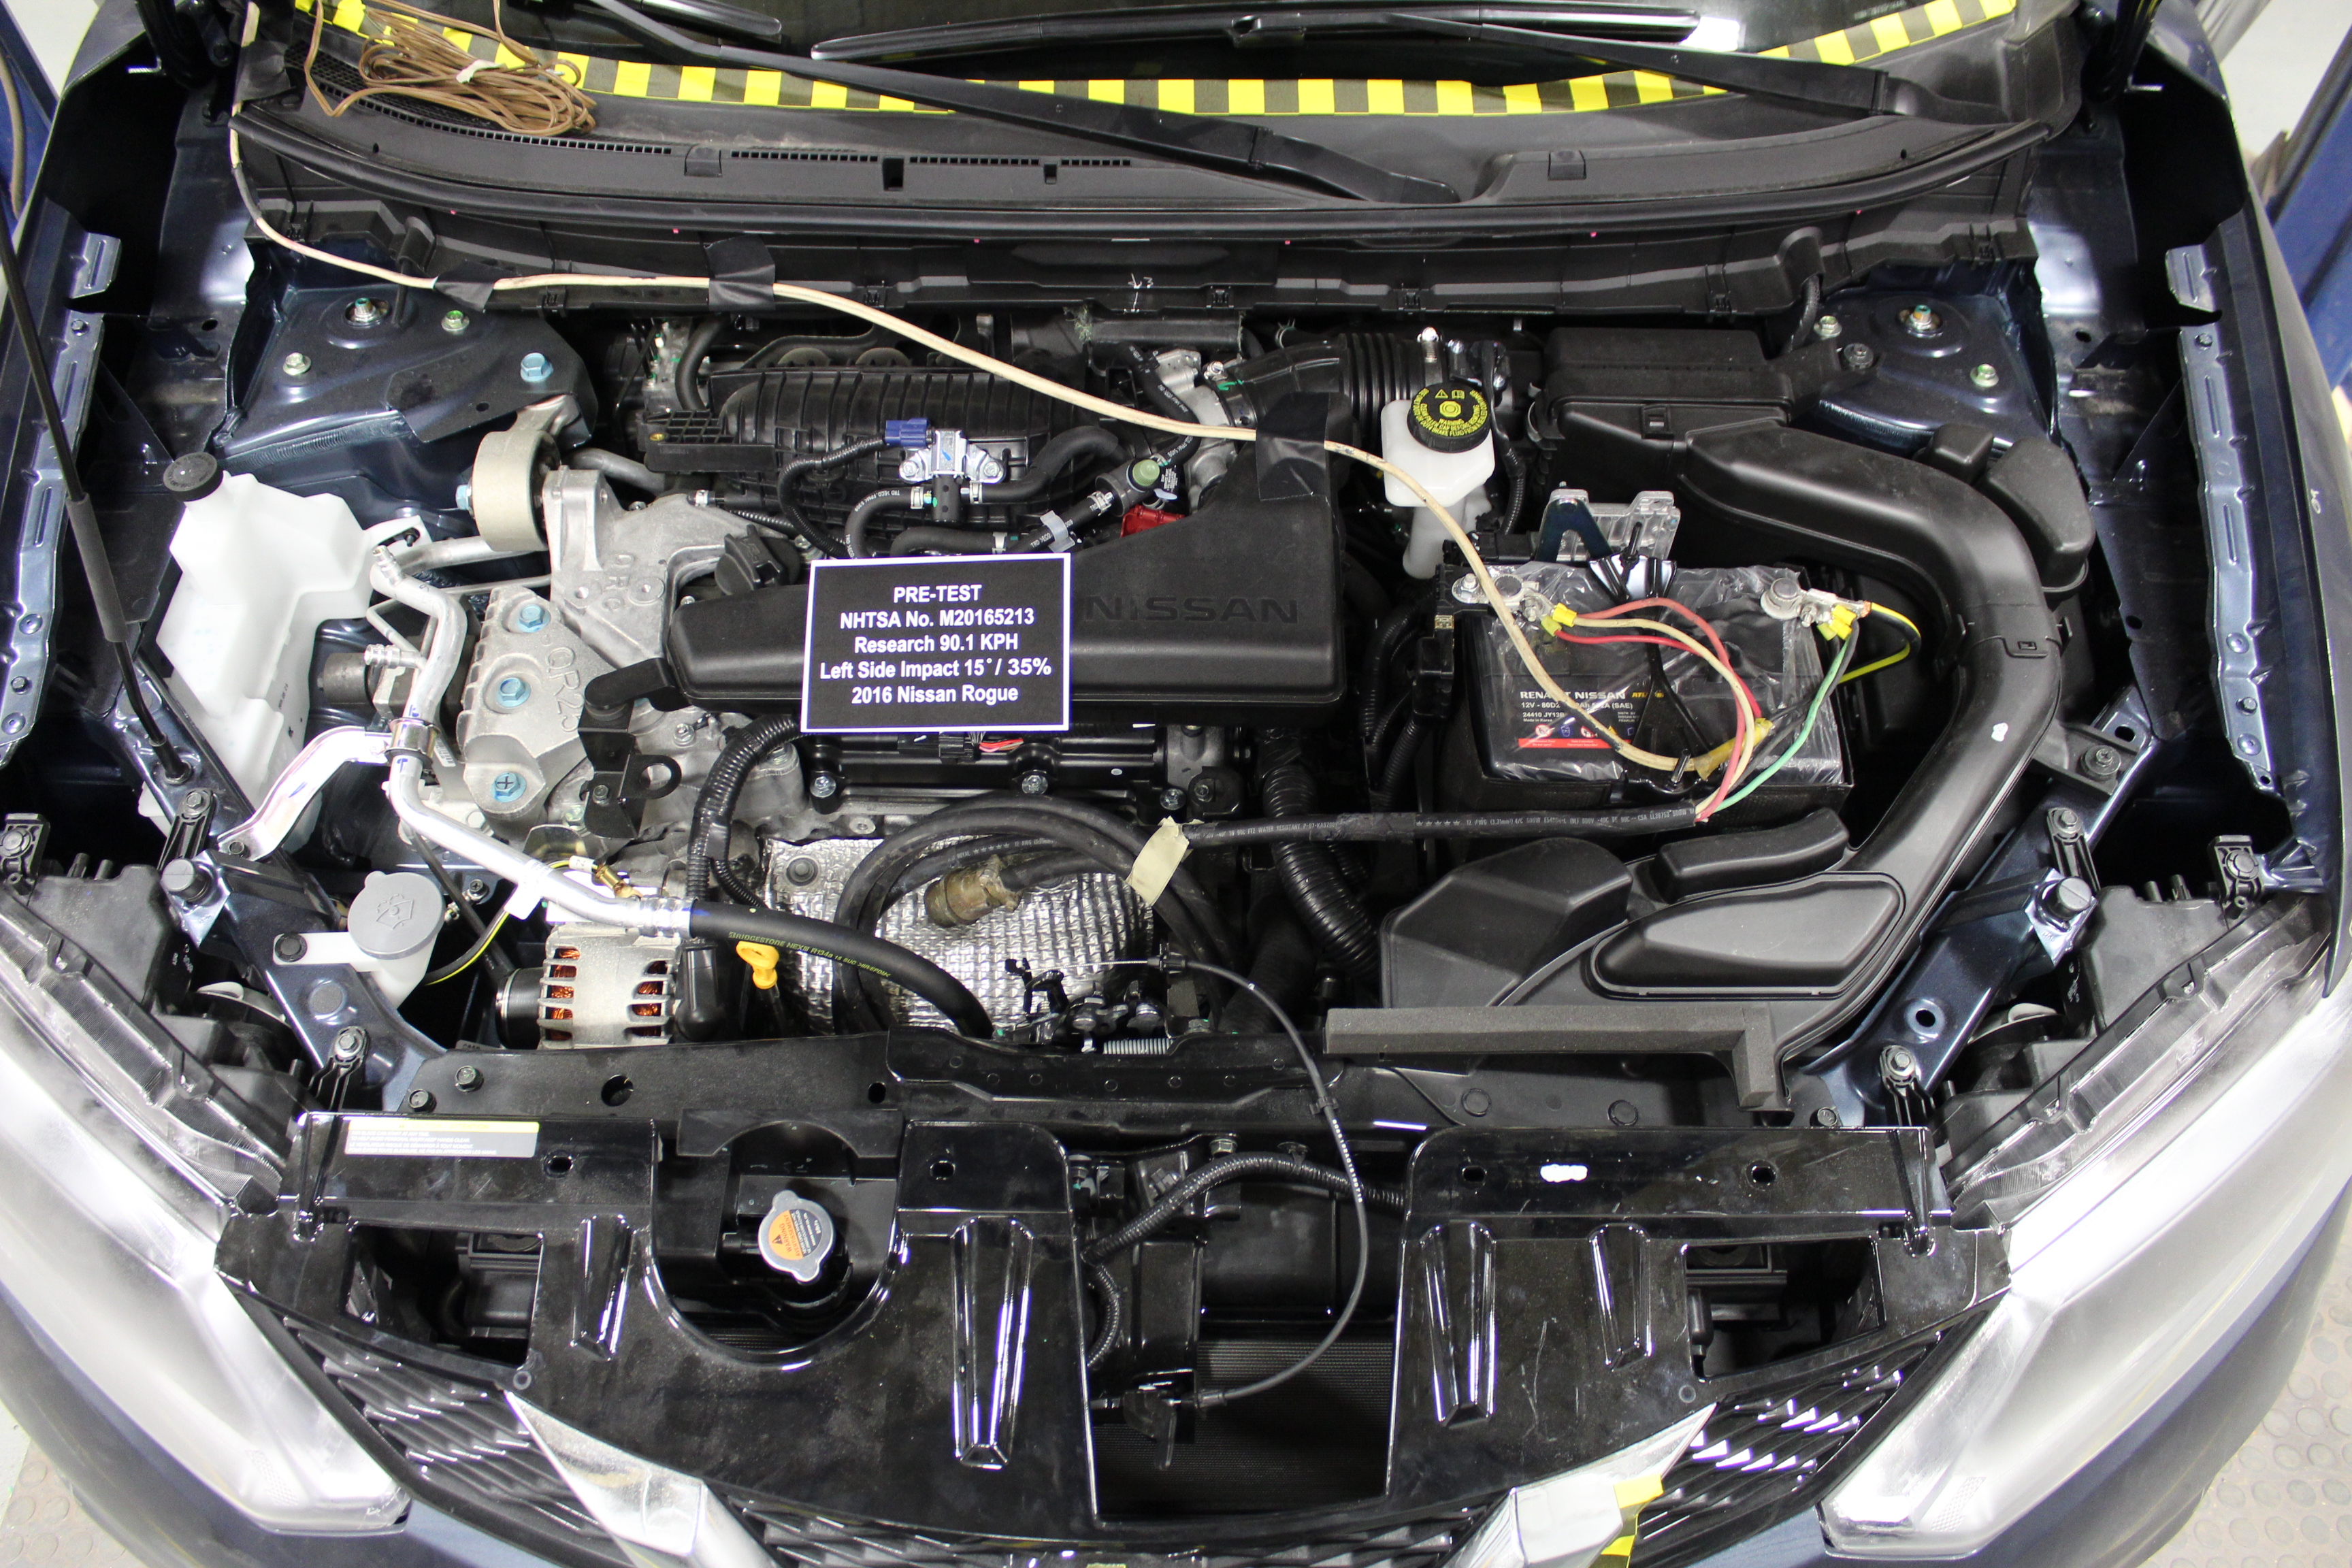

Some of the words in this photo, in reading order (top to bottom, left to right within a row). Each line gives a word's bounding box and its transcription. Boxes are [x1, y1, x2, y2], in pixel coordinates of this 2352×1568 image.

[893, 584, 983, 604] PRE-TEST
[840, 610, 902, 630] NHTSA
[905, 610, 934, 628] No.
[938, 607, 1035, 627] M20165213
[1085, 595, 1298, 624] NISSAN
[854, 634, 935, 654] Research
[939, 633, 974, 652] 90.1
[980, 632, 1019, 651] KPH
[819, 661, 854, 680] Left
[857, 660, 896, 679] Side
[900, 659, 960, 681] Impact
[1007, 657, 1052, 676] 35%
[851, 685, 893, 704] 2016
[896, 685, 957, 704] Nissan
[961, 684, 1019, 706] Rogue
[1575, 691, 1627, 700] NISSAN
[728, 931, 785, 947] BRIDGESTONE
[779, 1223, 792, 1252] WARNING
[784, 1214, 800, 1256] AVERTISSEMENT
